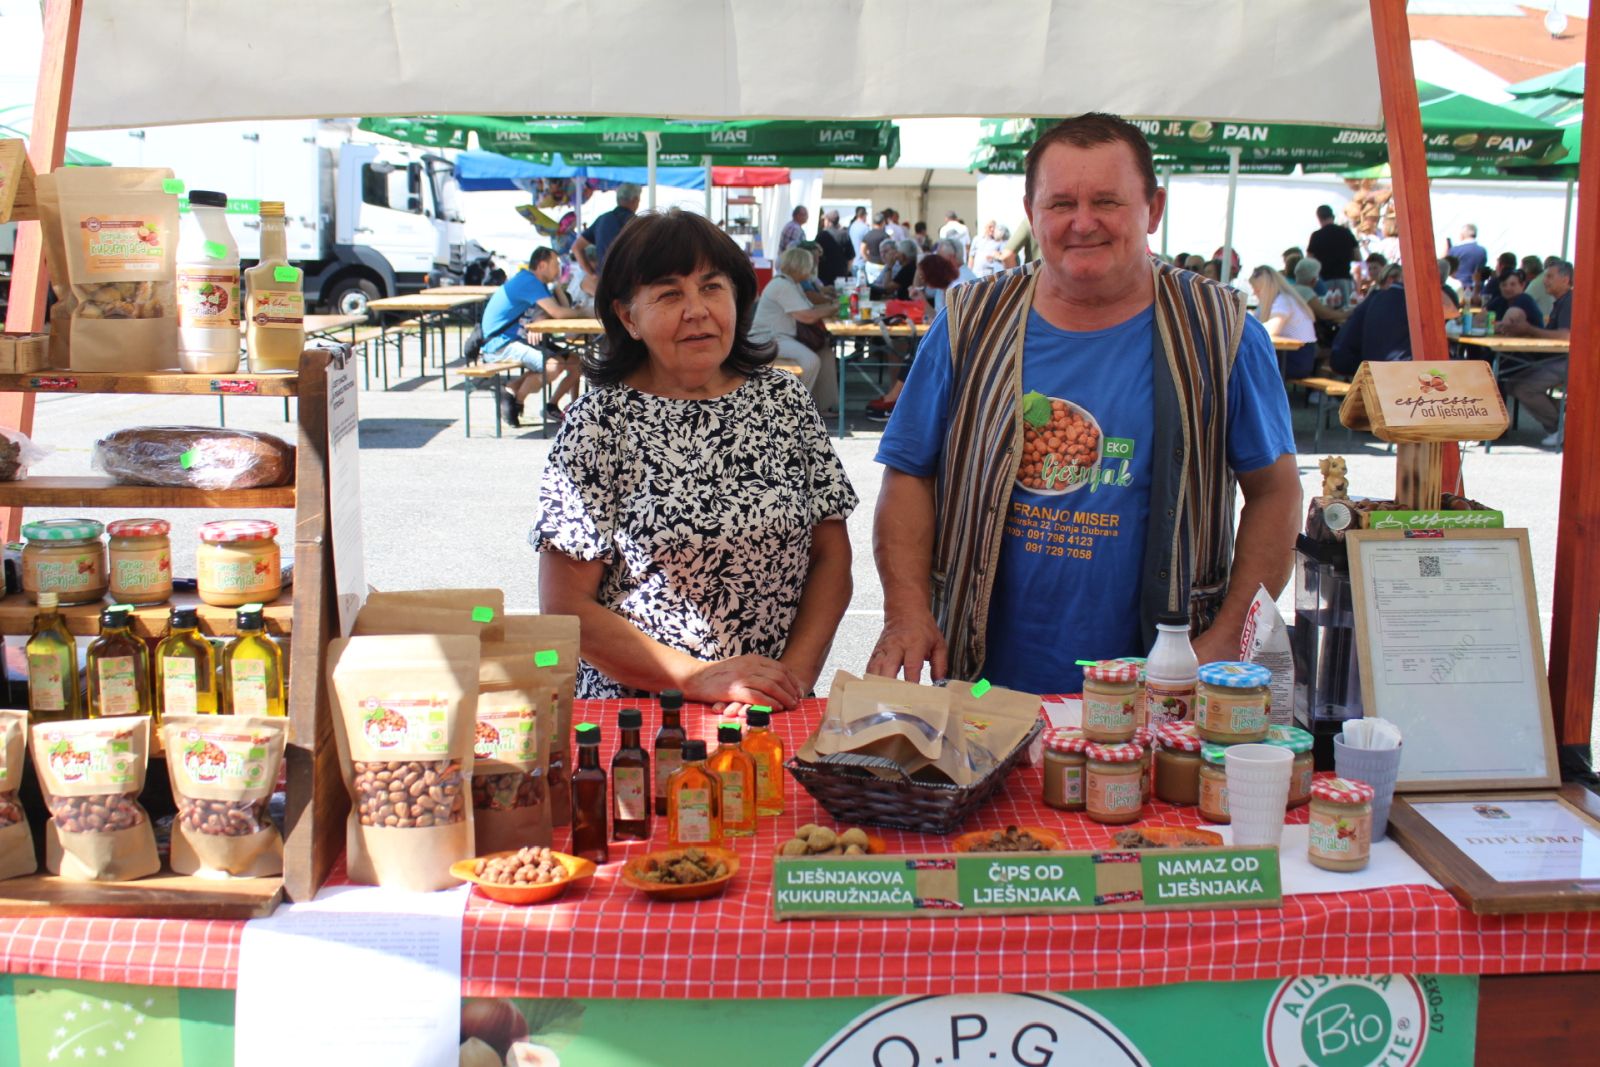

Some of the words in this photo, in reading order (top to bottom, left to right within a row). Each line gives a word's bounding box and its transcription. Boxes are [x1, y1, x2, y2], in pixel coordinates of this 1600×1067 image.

[1222, 124, 1269, 141] PAN
[1485, 135, 1533, 153] PAN
[1395, 395, 1484, 418] espresso
[1421, 406, 1435, 420] od
[1437, 404, 1489, 422] lješnjaka
[1106, 443, 1129, 454] EKO
[1041, 454, 1134, 493] lješnjak
[1013, 502, 1070, 521] FRANJO
[1073, 511, 1119, 528] MISER
[1027, 529, 1045, 540] 091
[1047, 532, 1065, 543] 796
[1067, 535, 1094, 547] 4123
[1054, 522, 1080, 535] Donja
[1082, 525, 1119, 537] Dubrava
[1025, 541, 1043, 553] 091
[1046, 544, 1064, 556] 729
[1067, 547, 1093, 559] 7058
[1463, 834, 1584, 845] DIPLOMA
[787, 867, 905, 885] LJEŠNJAKOVA
[988, 863, 1030, 882] ČIPS
[1034, 864, 1063, 881] OD
[1158, 857, 1227, 878] NAMAZ
[1230, 856, 1260, 873] OD
[778, 887, 915, 905] KUKURUŽNJAČA
[973, 884, 1081, 904] LJEŠNJAKA
[1158, 876, 1264, 899] LJEŠNJAKA
[1305, 1003, 1383, 1056] Bio
